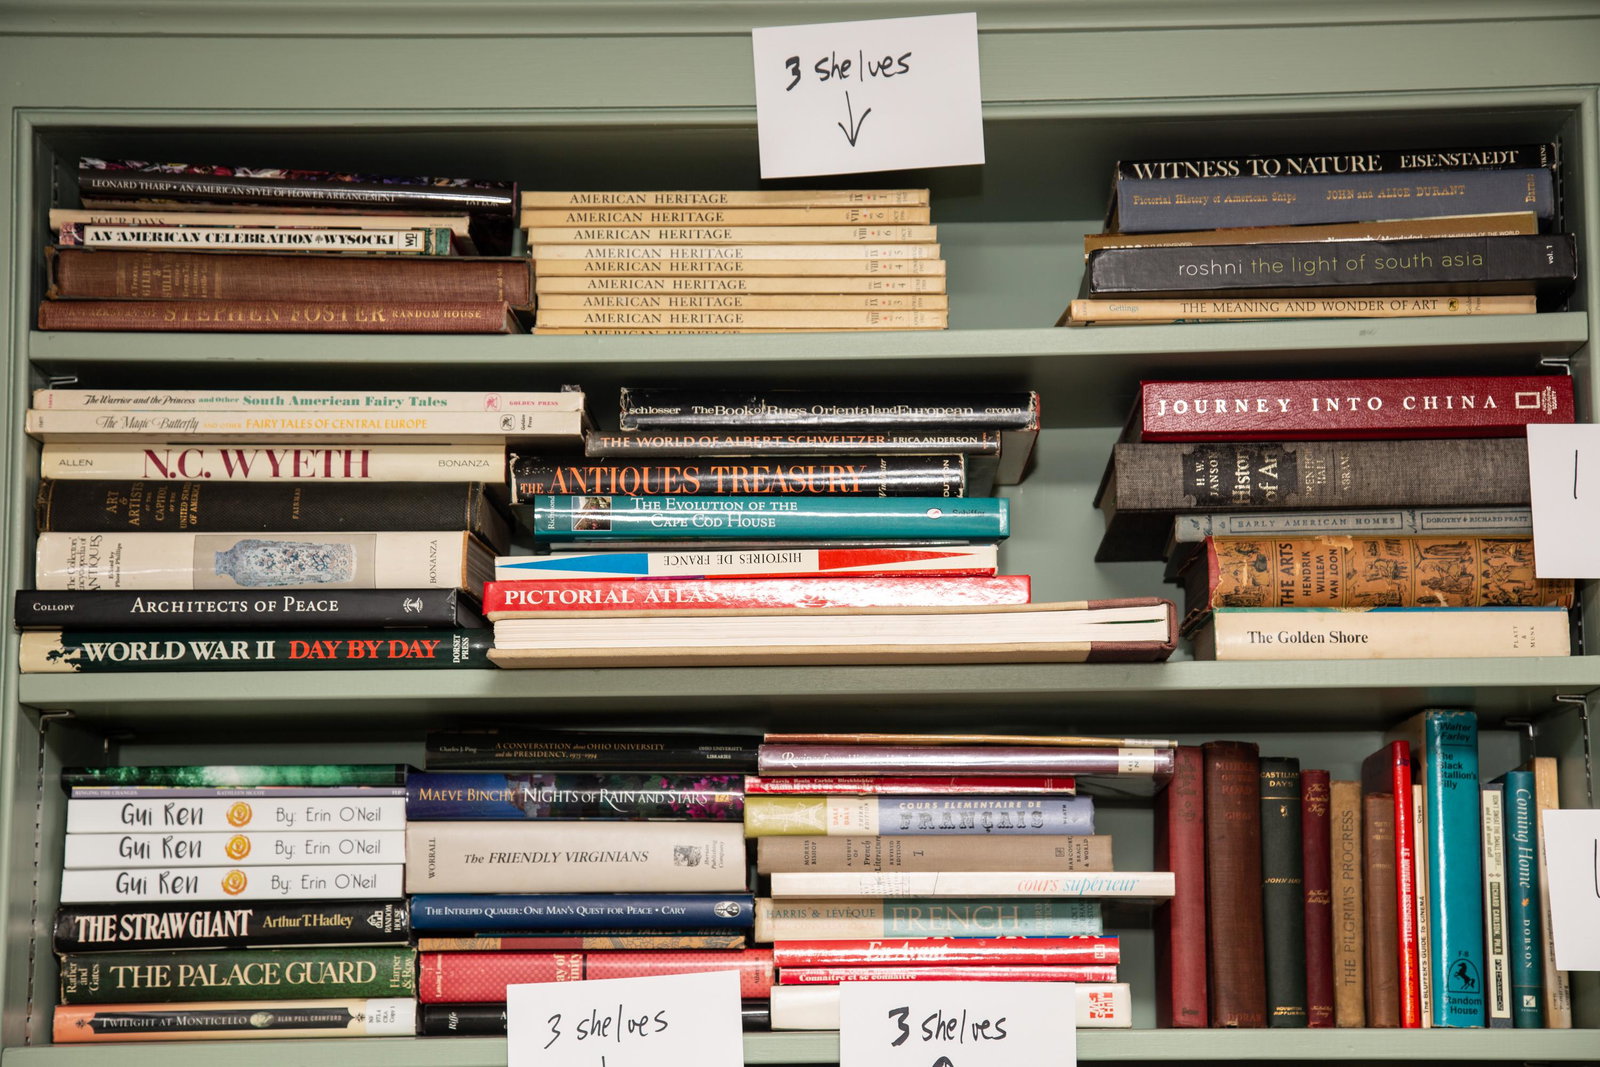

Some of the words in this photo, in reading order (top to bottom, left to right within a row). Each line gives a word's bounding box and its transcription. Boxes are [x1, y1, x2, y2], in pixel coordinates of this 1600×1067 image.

[785, 56, 801, 91] 3
[815, 50, 912, 81] shelves
[1133, 160, 1240, 180] WITNESS
[1246, 159, 1281, 177] TO
[1287, 154, 1383, 176] NATURE
[1401, 150, 1519, 169] EISENSTAEDT
[570, 193, 646, 204] AMERICAN
[655, 193, 728, 204] HERITAGE
[1133, 195, 1171, 205] Pictorial
[1175, 194, 1209, 205] History
[1213, 194, 1221, 203] of
[1224, 193, 1268, 203] American
[1271, 192, 1297, 203] Ships
[1326, 189, 1354, 200] JOHN
[1357, 189, 1373, 199] and
[1378, 188, 1410, 198] ALICE
[1416, 185, 1466, 197] DURANT
[566, 212, 643, 223] AMERICAN
[651, 212, 724, 222] HERITAGE
[90, 232, 112, 242] AN
[117, 232, 200, 242] AMERICAN
[205, 232, 313, 244] CELEBRATION
[324, 234, 394, 245] WYSOCKI
[585, 261, 661, 271] AMERICAN
[670, 261, 744, 271] HERITAGE
[1178, 259, 1243, 276] roshni
[1251, 257, 1284, 274] the
[1291, 256, 1337, 276] light
[1346, 254, 1366, 271] of
[1375, 252, 1433, 270] south
[1442, 253, 1483, 267] asia
[588, 279, 665, 289] AMERICAN
[673, 280, 747, 290] HERITAGE
[584, 297, 661, 307] AMERICAN
[669, 297, 743, 307] HERITAGE
[1180, 302, 1207, 313] THE
[1213, 302, 1279, 313] MEANING
[1285, 301, 1316, 312] AND
[1322, 299, 1388, 312] WONDER
[1390, 300, 1408, 311] OF
[1412, 300, 1438, 310] ART
[584, 313, 662, 323] AMERICAN
[670, 314, 744, 323] HERITAGE
[984, 407, 1022, 415] crown
[1158, 399, 1291, 416] JOURNEY
[1312, 397, 1383, 412] INTO
[1403, 395, 1498, 410] CHINA
[600, 437, 630, 448] THE
[636, 437, 695, 448] WORLD
[699, 436, 719, 447] OF
[724, 436, 783, 447] ALBERT
[788, 435, 885, 447] SCHWEITZER
[923, 436, 978, 444] ANDERSON
[59, 459, 94, 467] ALLEN
[142, 448, 211, 479] N.C.
[217, 448, 372, 479] WYETH
[520, 482, 544, 494] THE
[547, 466, 700, 497] ANTIQUES
[710, 465, 867, 494] TREASURY
[630, 497, 661, 511] THE
[666, 498, 745, 511] EVOLUTION
[749, 502, 765, 511] OF
[769, 502, 798, 511] THE
[1239, 520, 1275, 528] EARLY
[1284, 519, 1347, 527] AMERICAN
[429, 540, 438, 584] BONANZA
[664, 555, 710, 566] FRANCE
[717, 555, 733, 565] DE
[740, 552, 802, 564] HISTOIRES
[1279, 543, 1293, 576] ARTS
[1330, 549, 1338, 578] LOON
[1302, 551, 1311, 597] HENDRIK
[1317, 555, 1325, 593] WILLEM
[504, 589, 634, 605] PICTORIAL
[645, 589, 718, 603] ATLAS
[1280, 580, 1295, 606] THE
[1330, 581, 1338, 600] VAN
[130, 597, 248, 613] ARCHITECTS
[254, 601, 277, 612] OF
[283, 596, 339, 612] PEACE
[1247, 631, 1273, 644] The
[1278, 631, 1326, 644] Golden
[1330, 631, 1369, 644] Shore
[82, 641, 186, 662] WORLD
[188, 640, 250, 661] WAR
[255, 640, 276, 659] II
[289, 640, 343, 660] DAY
[346, 640, 385, 659] BY
[387, 640, 441, 659] DAY
[453, 634, 461, 663] DORSET
[419, 788, 463, 801] MAEVE
[467, 788, 516, 801] BINCHY
[523, 788, 578, 802] NIGHTS
[581, 793, 596, 802] OF
[600, 788, 635, 812] RAIN
[639, 794, 665, 803] AND
[667, 790, 708, 807] STARS
[121, 803, 152, 826] Gui
[164, 802, 203, 826] Ren
[276, 807, 296, 827] By:
[306, 807, 331, 821] Erin
[339, 807, 381, 821] O'Neil
[899, 802, 938, 810] COURS
[944, 801, 1022, 809] ELEMENTAIRE
[119, 836, 150, 859] Gui
[162, 835, 202, 859] Ren
[275, 840, 295, 860] By:
[305, 840, 330, 854] Erin
[339, 839, 380, 854] O'Neil
[1342, 810, 1354, 881] PROGRESS
[428, 838, 436, 879] WORRALL
[464, 854, 484, 864] The
[488, 852, 561, 863] FRIENDLY
[566, 850, 649, 863] VIRGINIANS
[384, 904, 392, 933] RANDOM
[425, 906, 443, 915] THE
[444, 907, 482, 915] INTREPID
[484, 907, 523, 918] QUAKER:
[524, 906, 543, 915] ONE
[546, 906, 574, 915] MAN'S
[576, 906, 604, 917] QUEST
[627, 906, 653, 914] PEACE
[662, 906, 686, 914] CARY
[1343, 887, 1356, 953] PILGRIM'S
[74, 915, 117, 943] THE
[119, 912, 190, 941] STRAW
[189, 909, 253, 938] GIANT
[262, 915, 302, 928] Arthur
[302, 914, 312, 926] T.
[313, 913, 353, 929] Hadley
[1523, 919, 1533, 968] DOBSON
[66, 962, 78, 993] Rather
[78, 968, 88, 986] and
[109, 965, 172, 989] THE
[177, 962, 281, 987] PALACE
[285, 961, 377, 985] GUARD
[390, 955, 400, 988] Harper
[1345, 959, 1356, 986] THE
[543, 1013, 561, 1050] 3
[576, 1004, 669, 1043] shelves
[889, 1006, 909, 1047] 3
[921, 1009, 1007, 1044] shelves
